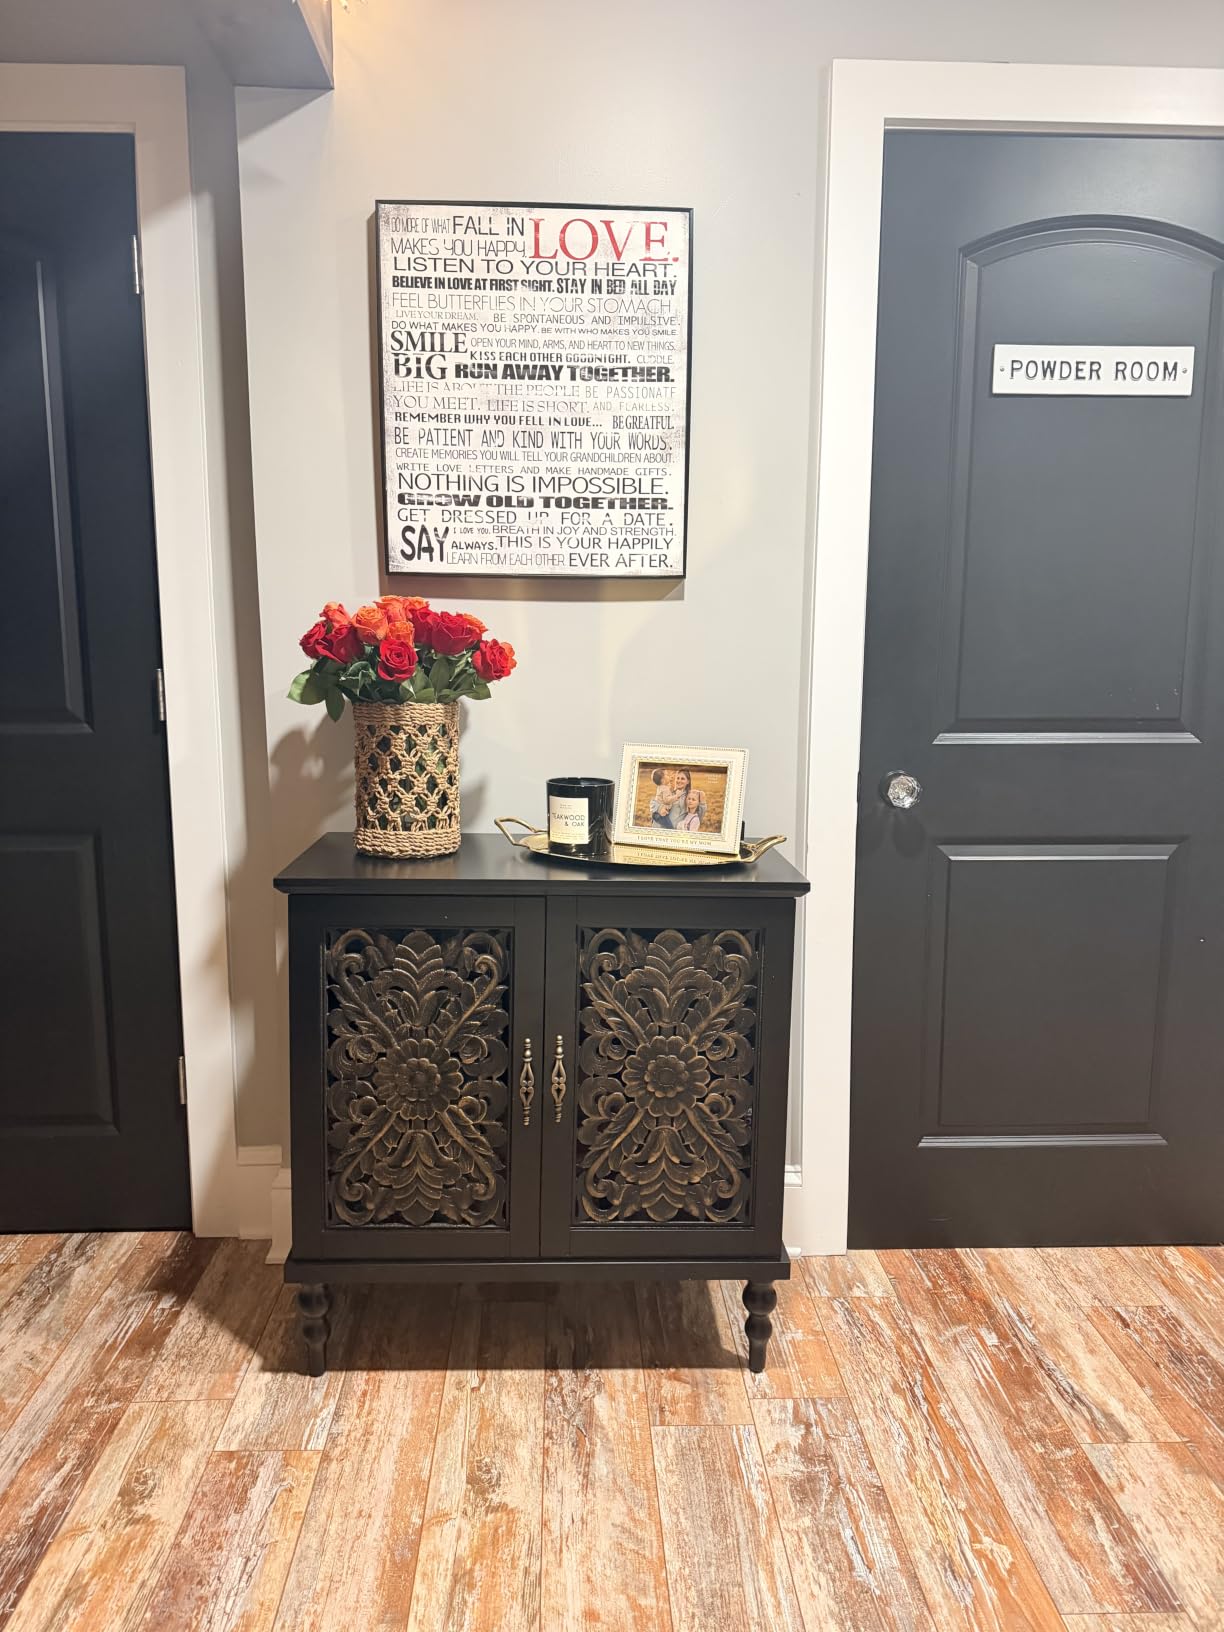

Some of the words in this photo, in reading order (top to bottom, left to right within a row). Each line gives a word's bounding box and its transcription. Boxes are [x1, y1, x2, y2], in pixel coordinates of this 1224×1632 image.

[432, 218, 451, 234] WHAT
[453, 216, 500, 236] FALL
[507, 217, 524, 236] IN
[391, 238, 440, 256] MAKES
[444, 238, 472, 256] YOU
[528, 218, 679, 262] LOVE.
[394, 256, 474, 274] LISTEN
[480, 260, 514, 274] TO
[520, 260, 586, 276] YOUR
[595, 262, 677, 278] HEART.
[392, 276, 432, 288] BELIEVE
[434, 277, 446, 290] IN
[448, 277, 472, 290] LOVE
[474, 278, 489, 291] AT
[490, 278, 519, 292] FIRST
[520, 279, 554, 292] SIGHT.
[556, 278, 586, 294] STAY
[591, 278, 602, 294] IN
[606, 279, 626, 295] BED
[630, 280, 650, 296] ALL
[654, 280, 677, 296] DAY
[392, 292, 424, 308] FEEL
[428, 294, 516, 311] BUTTERFLIES
[520, 296, 536, 312] IN
[540, 296, 583, 312] YOUR
[396, 310, 416, 319] LIVE
[418, 310, 444, 320] YOUR
[494, 314, 506, 322] BE
[514, 314, 584, 324] SPONTANEOUS
[591, 316, 612, 325] AND
[618, 316, 680, 326] IMPULSIVE.
[392, 320, 406, 330] DO
[410, 322, 439, 331] WHAT
[442, 322, 478, 332] MAKES
[480, 324, 502, 333] YOU
[390, 330, 468, 353] SMILE
[470, 338, 493, 348] OPEN
[496, 338, 516, 348] YOUR
[518, 338, 540, 350] MIND,
[543, 340, 566, 350] ARMS,
[568, 340, 585, 350] AND
[588, 340, 612, 350] HEART
[612, 340, 625, 350] TO
[628, 341, 645, 351] NEW
[470, 351, 496, 361] KISS
[500, 352, 526, 362] EACH
[530, 352, 562, 362] OTHER
[566, 354, 631, 364] GOODNIGHT.
[391, 352, 448, 380] BIG
[455, 362, 498, 379] RUN
[502, 364, 564, 380] AWAY
[567, 365, 675, 382] TOGETHER.
[1010, 360, 1102, 380] POWDER
[1114, 361, 1178, 381] ROOM
[394, 381, 424, 392] LIFE
[428, 382, 439, 393] IS
[496, 384, 522, 396] THE
[527, 384, 580, 397] PEOPLE
[586, 386, 598, 398] BE
[393, 395, 428, 408] YOU
[434, 396, 480, 410] MEET.
[488, 399, 518, 412] LIFE
[522, 400, 534, 412] IS
[538, 400, 590, 414] SHORT.
[593, 402, 612, 411] AND
[395, 412, 461, 424] REMEMBER
[464, 414, 490, 424] WHY
[494, 414, 516, 425] YOU
[519, 416, 544, 426] FELL
[548, 416, 561, 426] IN
[612, 416, 624, 430] BE
[394, 426, 409, 445] BE
[418, 428, 474, 447] PATIENT
[481, 430, 505, 448] AND
[512, 430, 544, 448] KIND
[551, 431, 582, 450] WITH
[590, 432, 620, 450] YOUR
[628, 432, 672, 450] WORDS.
[396, 448, 428, 459] CREATE
[432, 448, 478, 460] MEMORIES
[480, 450, 498, 461] YOU
[500, 450, 520, 462] WILL
[522, 451, 542, 462] TELL
[544, 452, 568, 462] YOUR
[570, 452, 642, 463] GRANDCHILDREN
[396, 462, 430, 472] WRITE
[436, 464, 462, 473] LOVE
[469, 464, 514, 474] LETTERS
[520, 466, 540, 474] AND
[546, 466, 572, 475] MAKE
[578, 467, 629, 476] HANDMADE
[636, 468, 672, 476] GIFTS.
[398, 472, 499, 492] NOTHING
[506, 475, 525, 493] IS
[532, 476, 668, 495] IMPOSSIBLE.
[398, 492, 482, 507] GROW
[486, 495, 534, 508] OLD
[539, 496, 674, 510] TOGETHER.
[398, 508, 430, 522] GET
[442, 510, 517, 524] DRESSED
[561, 512, 592, 526] FOR
[602, 512, 614, 526] A
[624, 512, 672, 526] DATE.
[492, 525, 540, 534] BREATH
[544, 526, 554, 534] IN
[557, 526, 580, 536] JOY
[582, 527, 607, 536] AND
[400, 524, 450, 562] SAY
[451, 541, 498, 551] ALWAYS.
[496, 536, 532, 548] THIS
[539, 536, 550, 548] IS
[556, 536, 602, 549] YOUR
[608, 538, 674, 550] HAPPILY
[447, 552, 478, 564] LEARN
[481, 552, 506, 565] FROM
[510, 553, 532, 566] EACH
[570, 553, 610, 567] EVER
[615, 554, 672, 568] AFTER.
